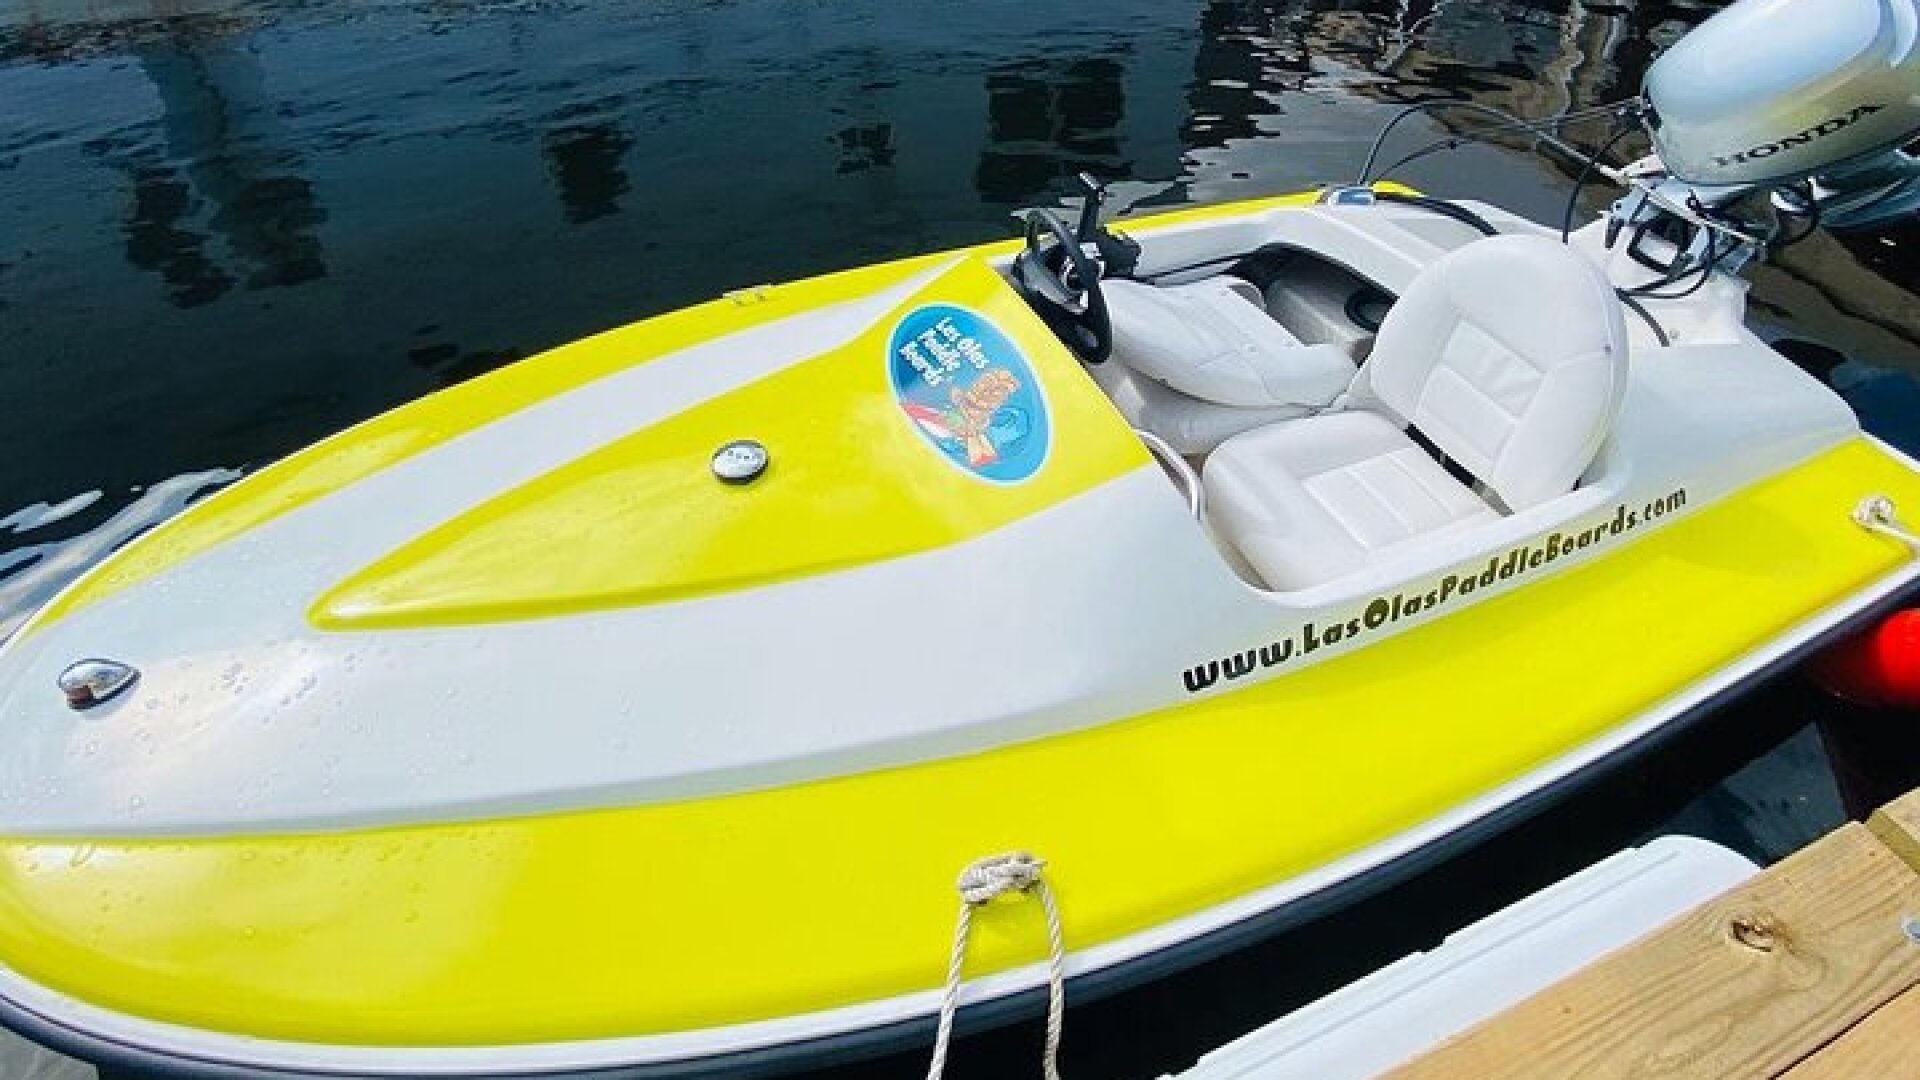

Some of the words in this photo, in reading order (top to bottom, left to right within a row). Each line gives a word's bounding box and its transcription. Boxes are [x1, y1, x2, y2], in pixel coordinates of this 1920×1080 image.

[1711, 103, 1888, 166] HONDA
[898, 341, 944, 387] Boards
[916, 328, 961, 372] Paddle
[935, 316, 962, 342] Las
[957, 338, 990, 369] Olas
[1183, 487, 1687, 692] www.LasOlasPaddleBoards.com
